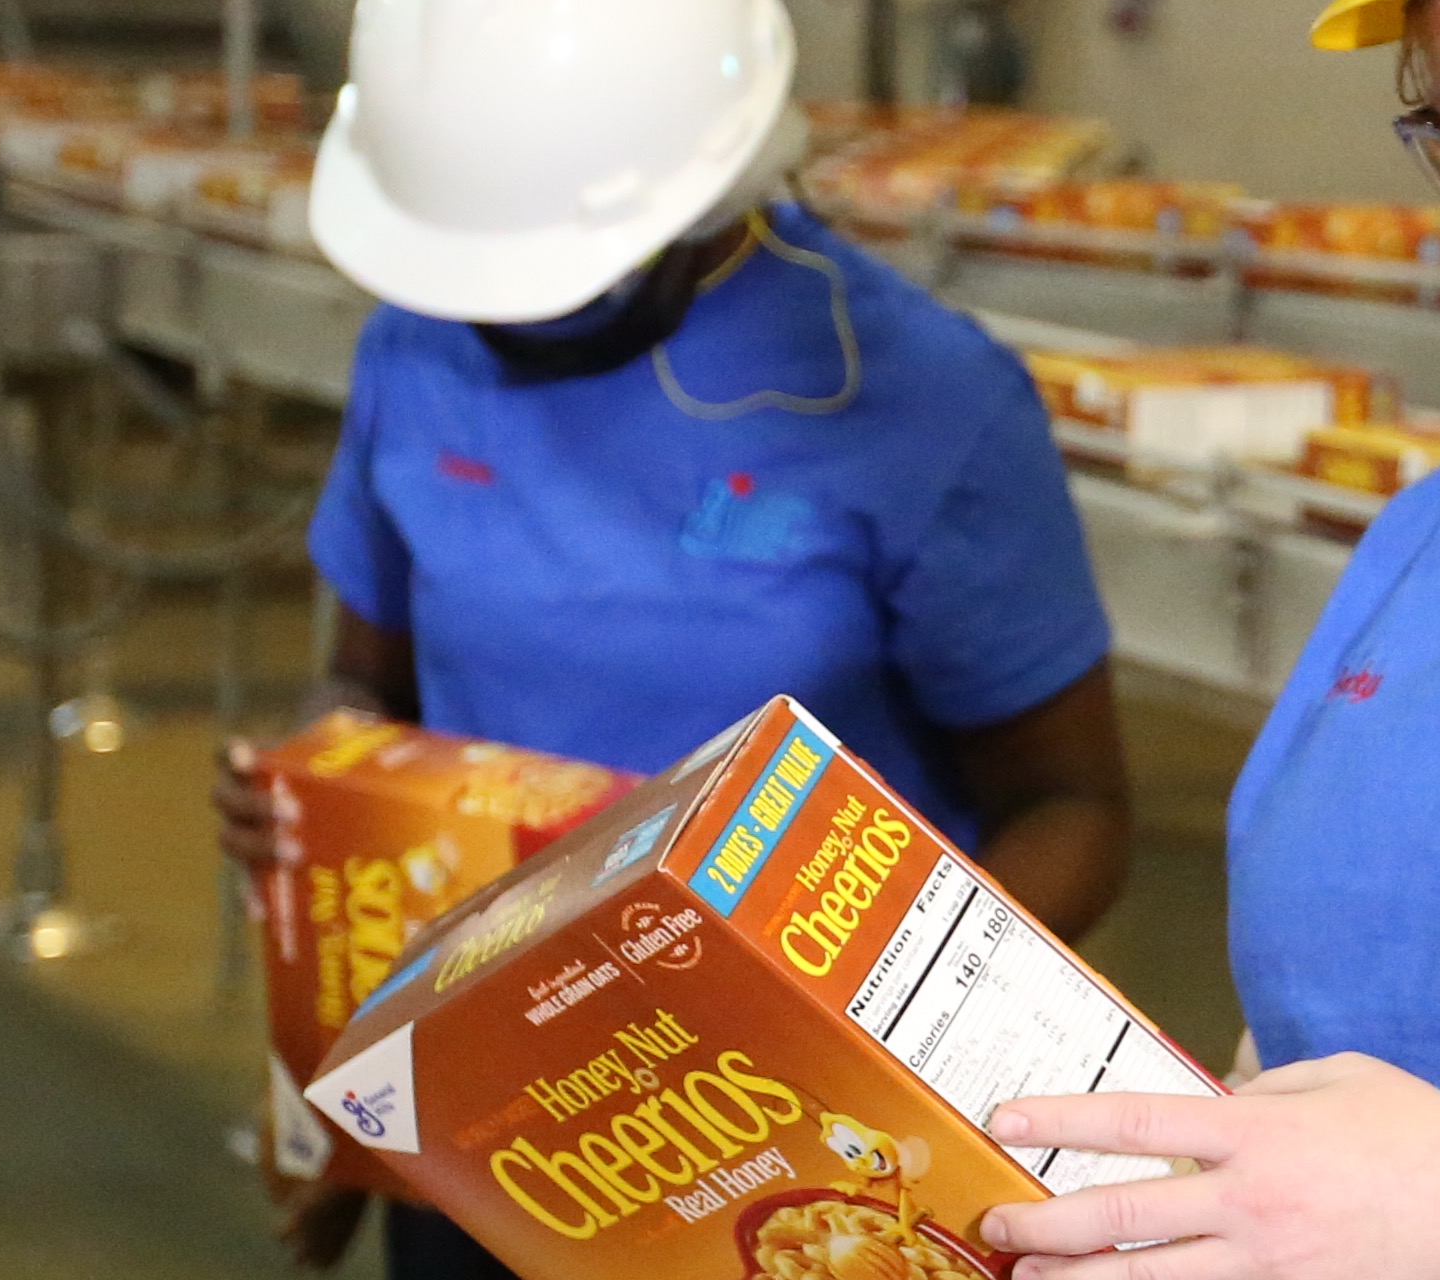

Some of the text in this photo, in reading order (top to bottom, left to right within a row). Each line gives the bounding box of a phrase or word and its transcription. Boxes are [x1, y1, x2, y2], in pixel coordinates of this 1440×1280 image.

[707, 736, 822, 894] 2 BOXES GREAT VALUE
[794, 794, 868, 892] Honey Nut
[619, 927, 676, 965] Gluten
[662, 908, 703, 938] Free
[780, 808, 911, 977] Cheerios
[850, 861, 953, 1018] Nutrition Facts
[524, 961, 621, 1027] WHOLE GRAIN OATS
[870, 980, 910, 1036] Serving size
[908, 1009, 951, 1068] Calories
[955, 952, 982, 990] 140
[983, 906, 1009, 943] 180
[523, 1008, 699, 1122] Honey Nut
[490, 1051, 803, 1240] Cheerios
[663, 1146, 798, 1223] Real Honey
